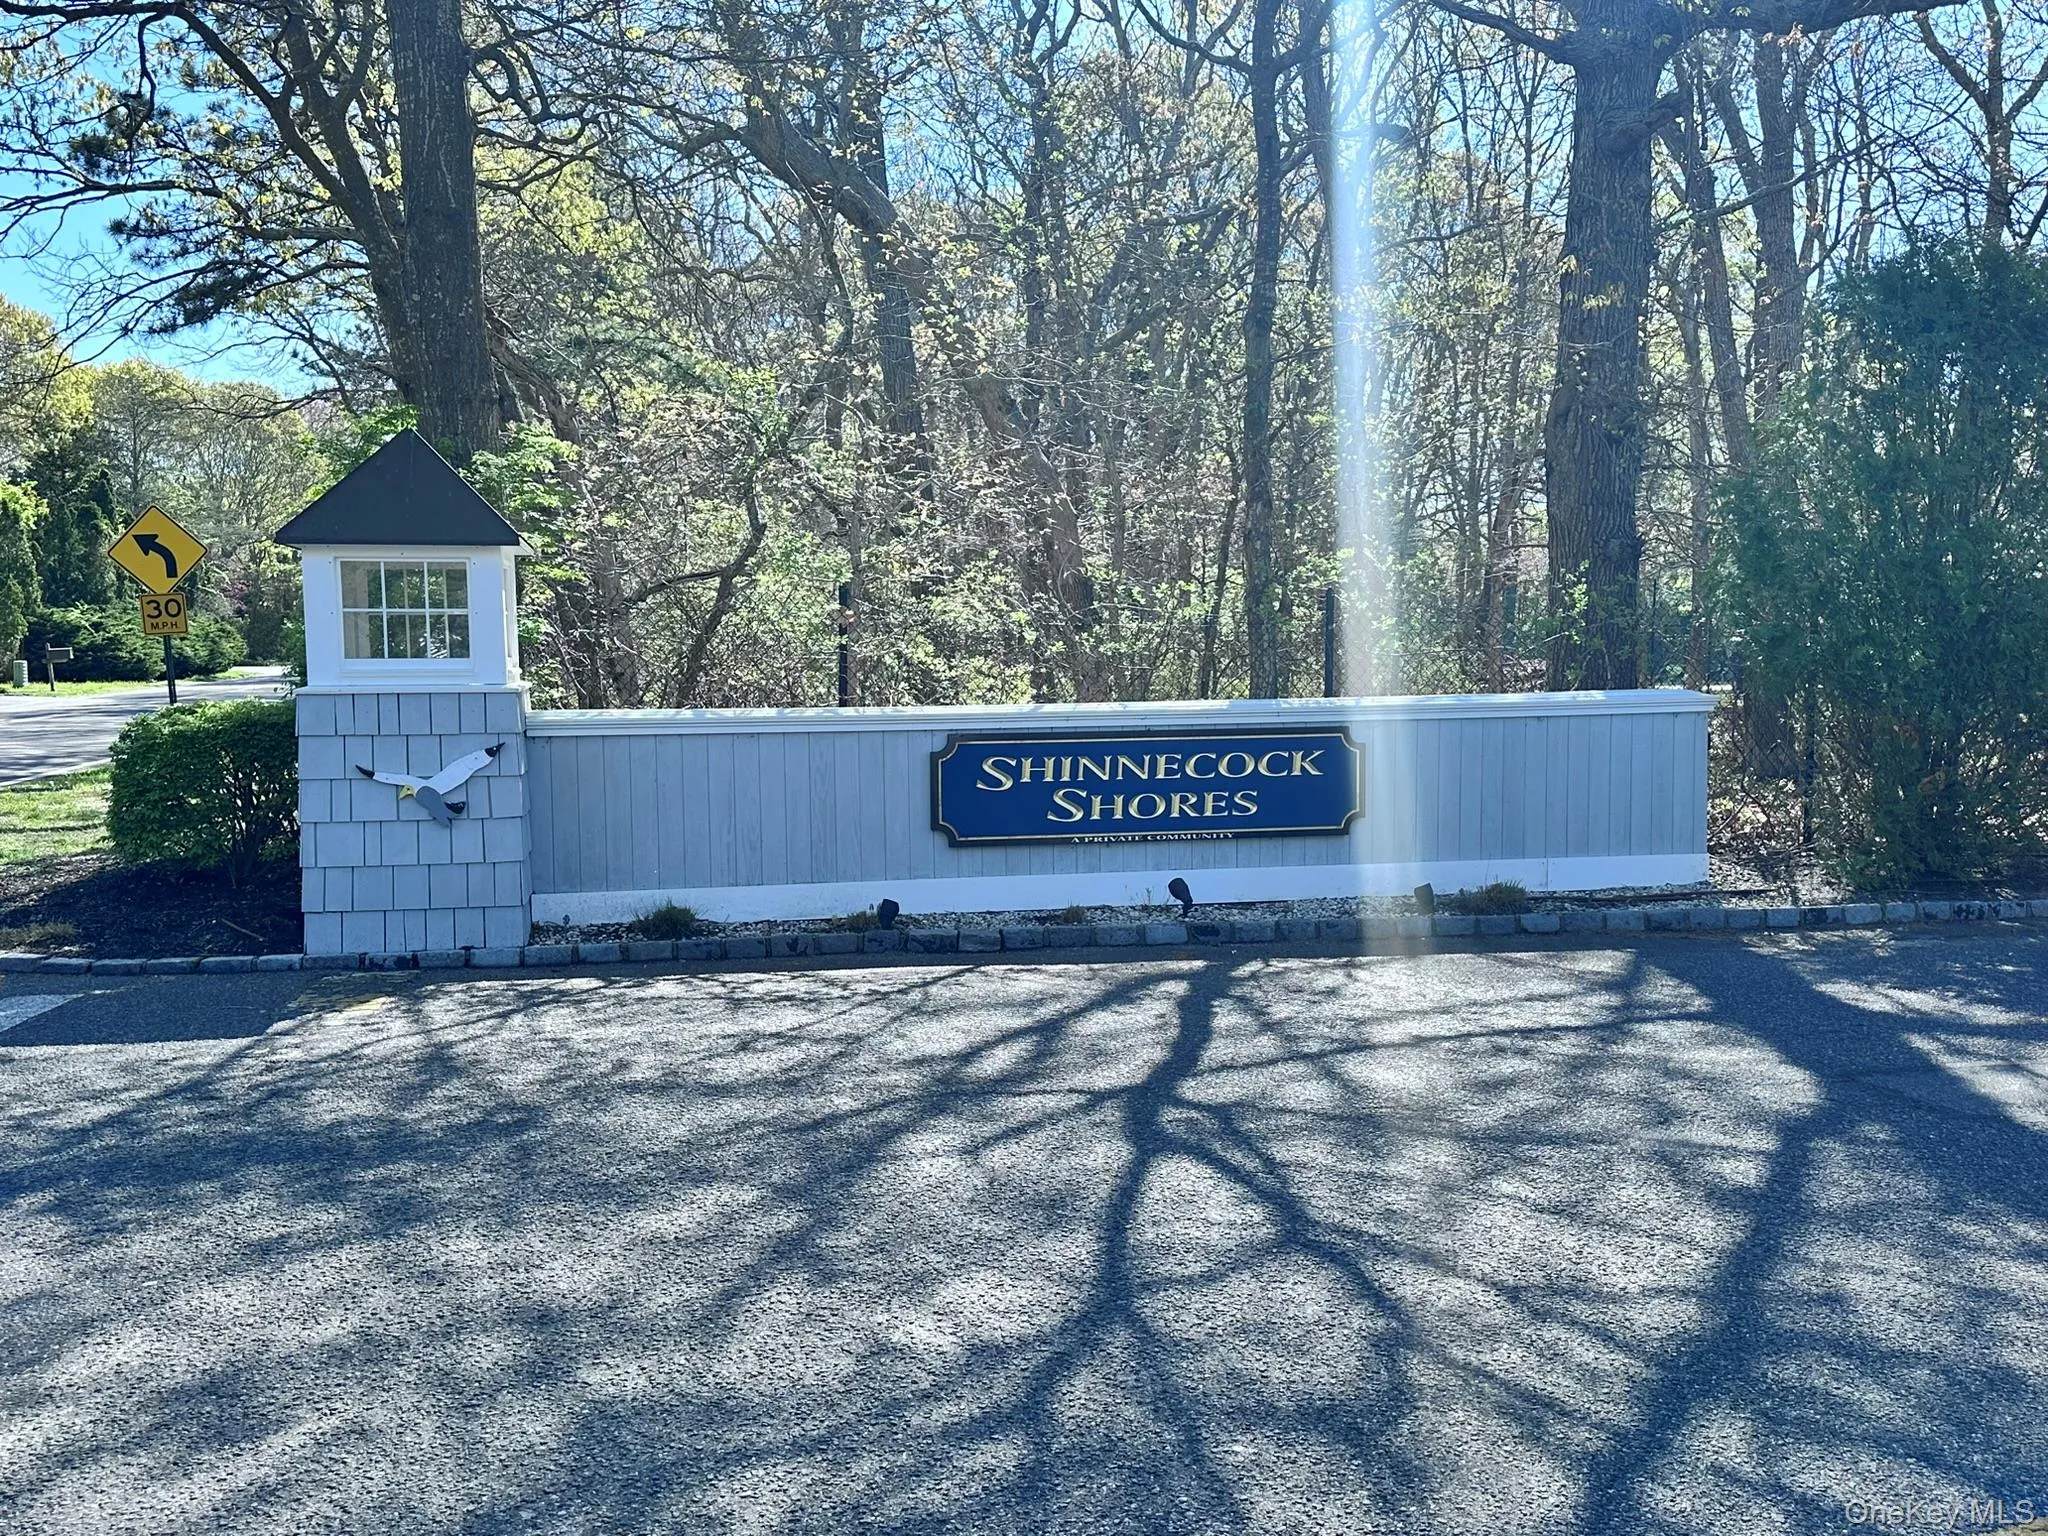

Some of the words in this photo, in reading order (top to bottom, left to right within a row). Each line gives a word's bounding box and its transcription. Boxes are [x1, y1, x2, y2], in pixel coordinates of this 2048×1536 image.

[145, 598, 182, 619] 30
[976, 749, 1326, 791] SHINNECOCK
[1047, 788, 1259, 822] SHORES
[1084, 835, 1142, 843] PRIVATE
[1147, 832, 1235, 841] COMMUNITY
